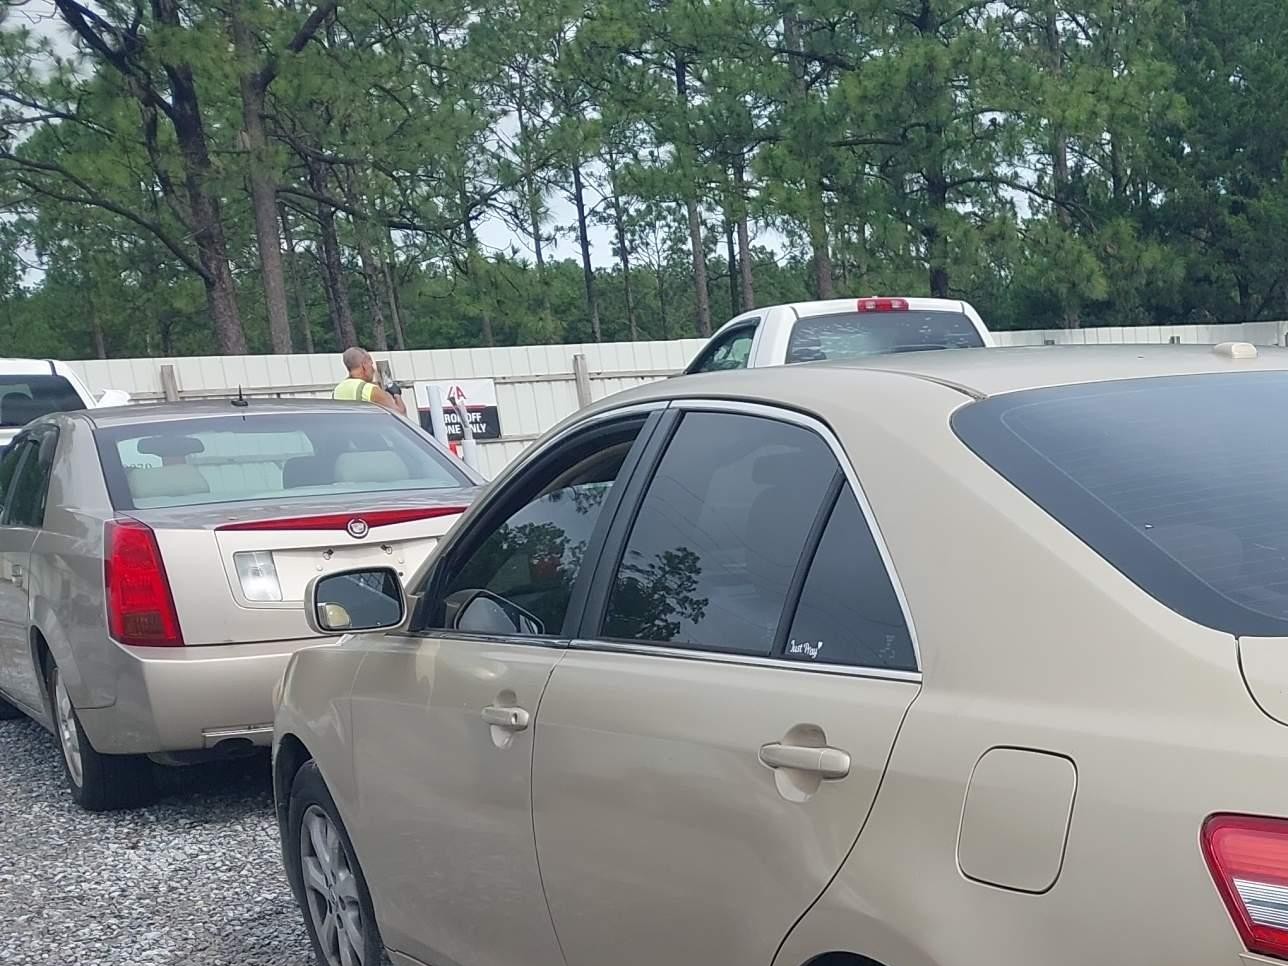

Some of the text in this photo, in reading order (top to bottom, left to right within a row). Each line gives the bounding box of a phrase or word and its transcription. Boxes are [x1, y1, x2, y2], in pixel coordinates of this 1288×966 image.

[470, 423, 487, 433] NLY
[789, 639, 818, 659] Just Pray
